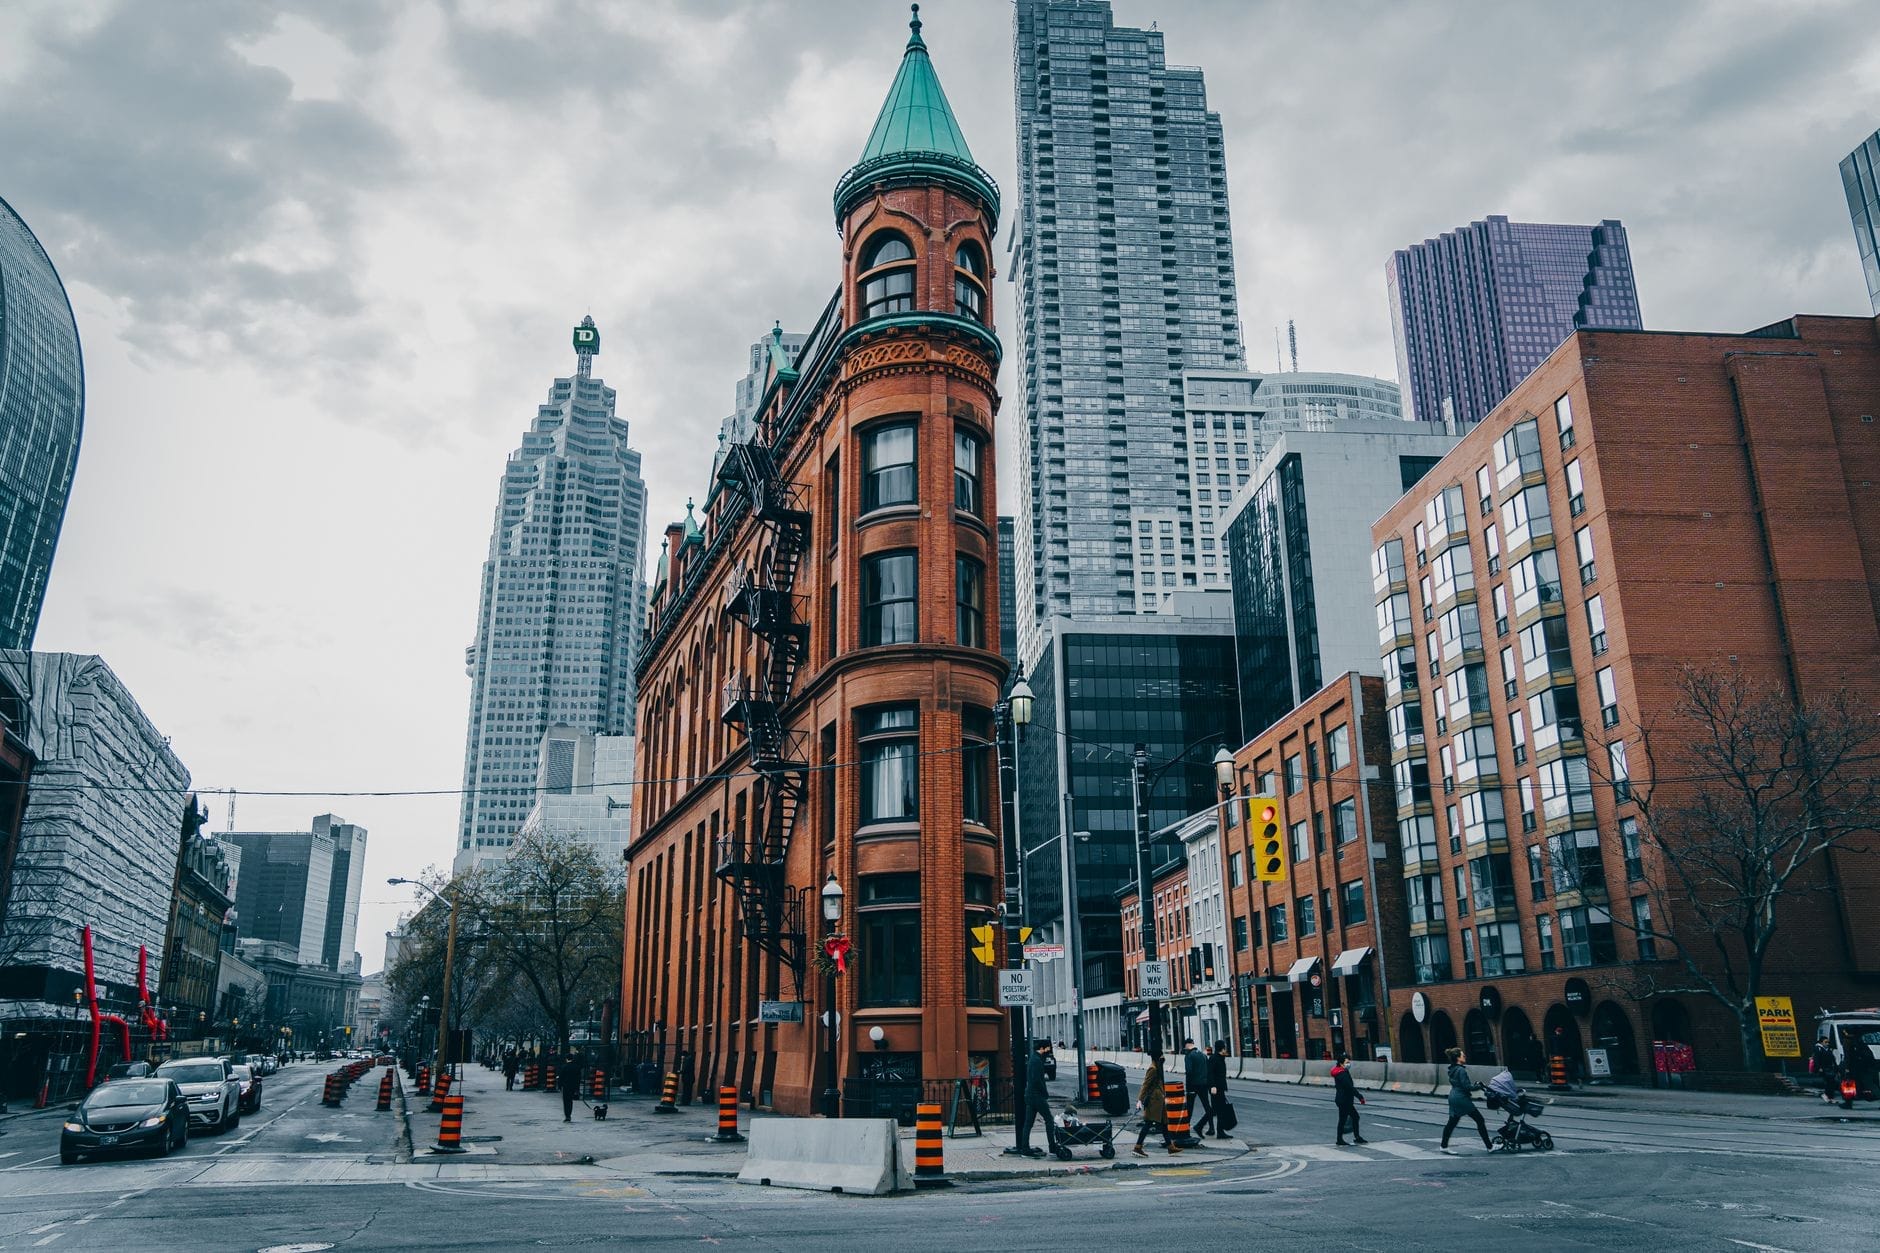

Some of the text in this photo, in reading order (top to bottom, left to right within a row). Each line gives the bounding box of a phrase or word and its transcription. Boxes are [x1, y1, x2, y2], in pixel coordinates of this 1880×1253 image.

[576, 330, 594, 341] TD
[1146, 965, 1161, 973] ONE
[1011, 974, 1023, 983] NO
[1147, 976, 1161, 985] WAY
[1142, 988, 1168, 997] BEGINS
[1759, 1009, 1792, 1017] PARK
